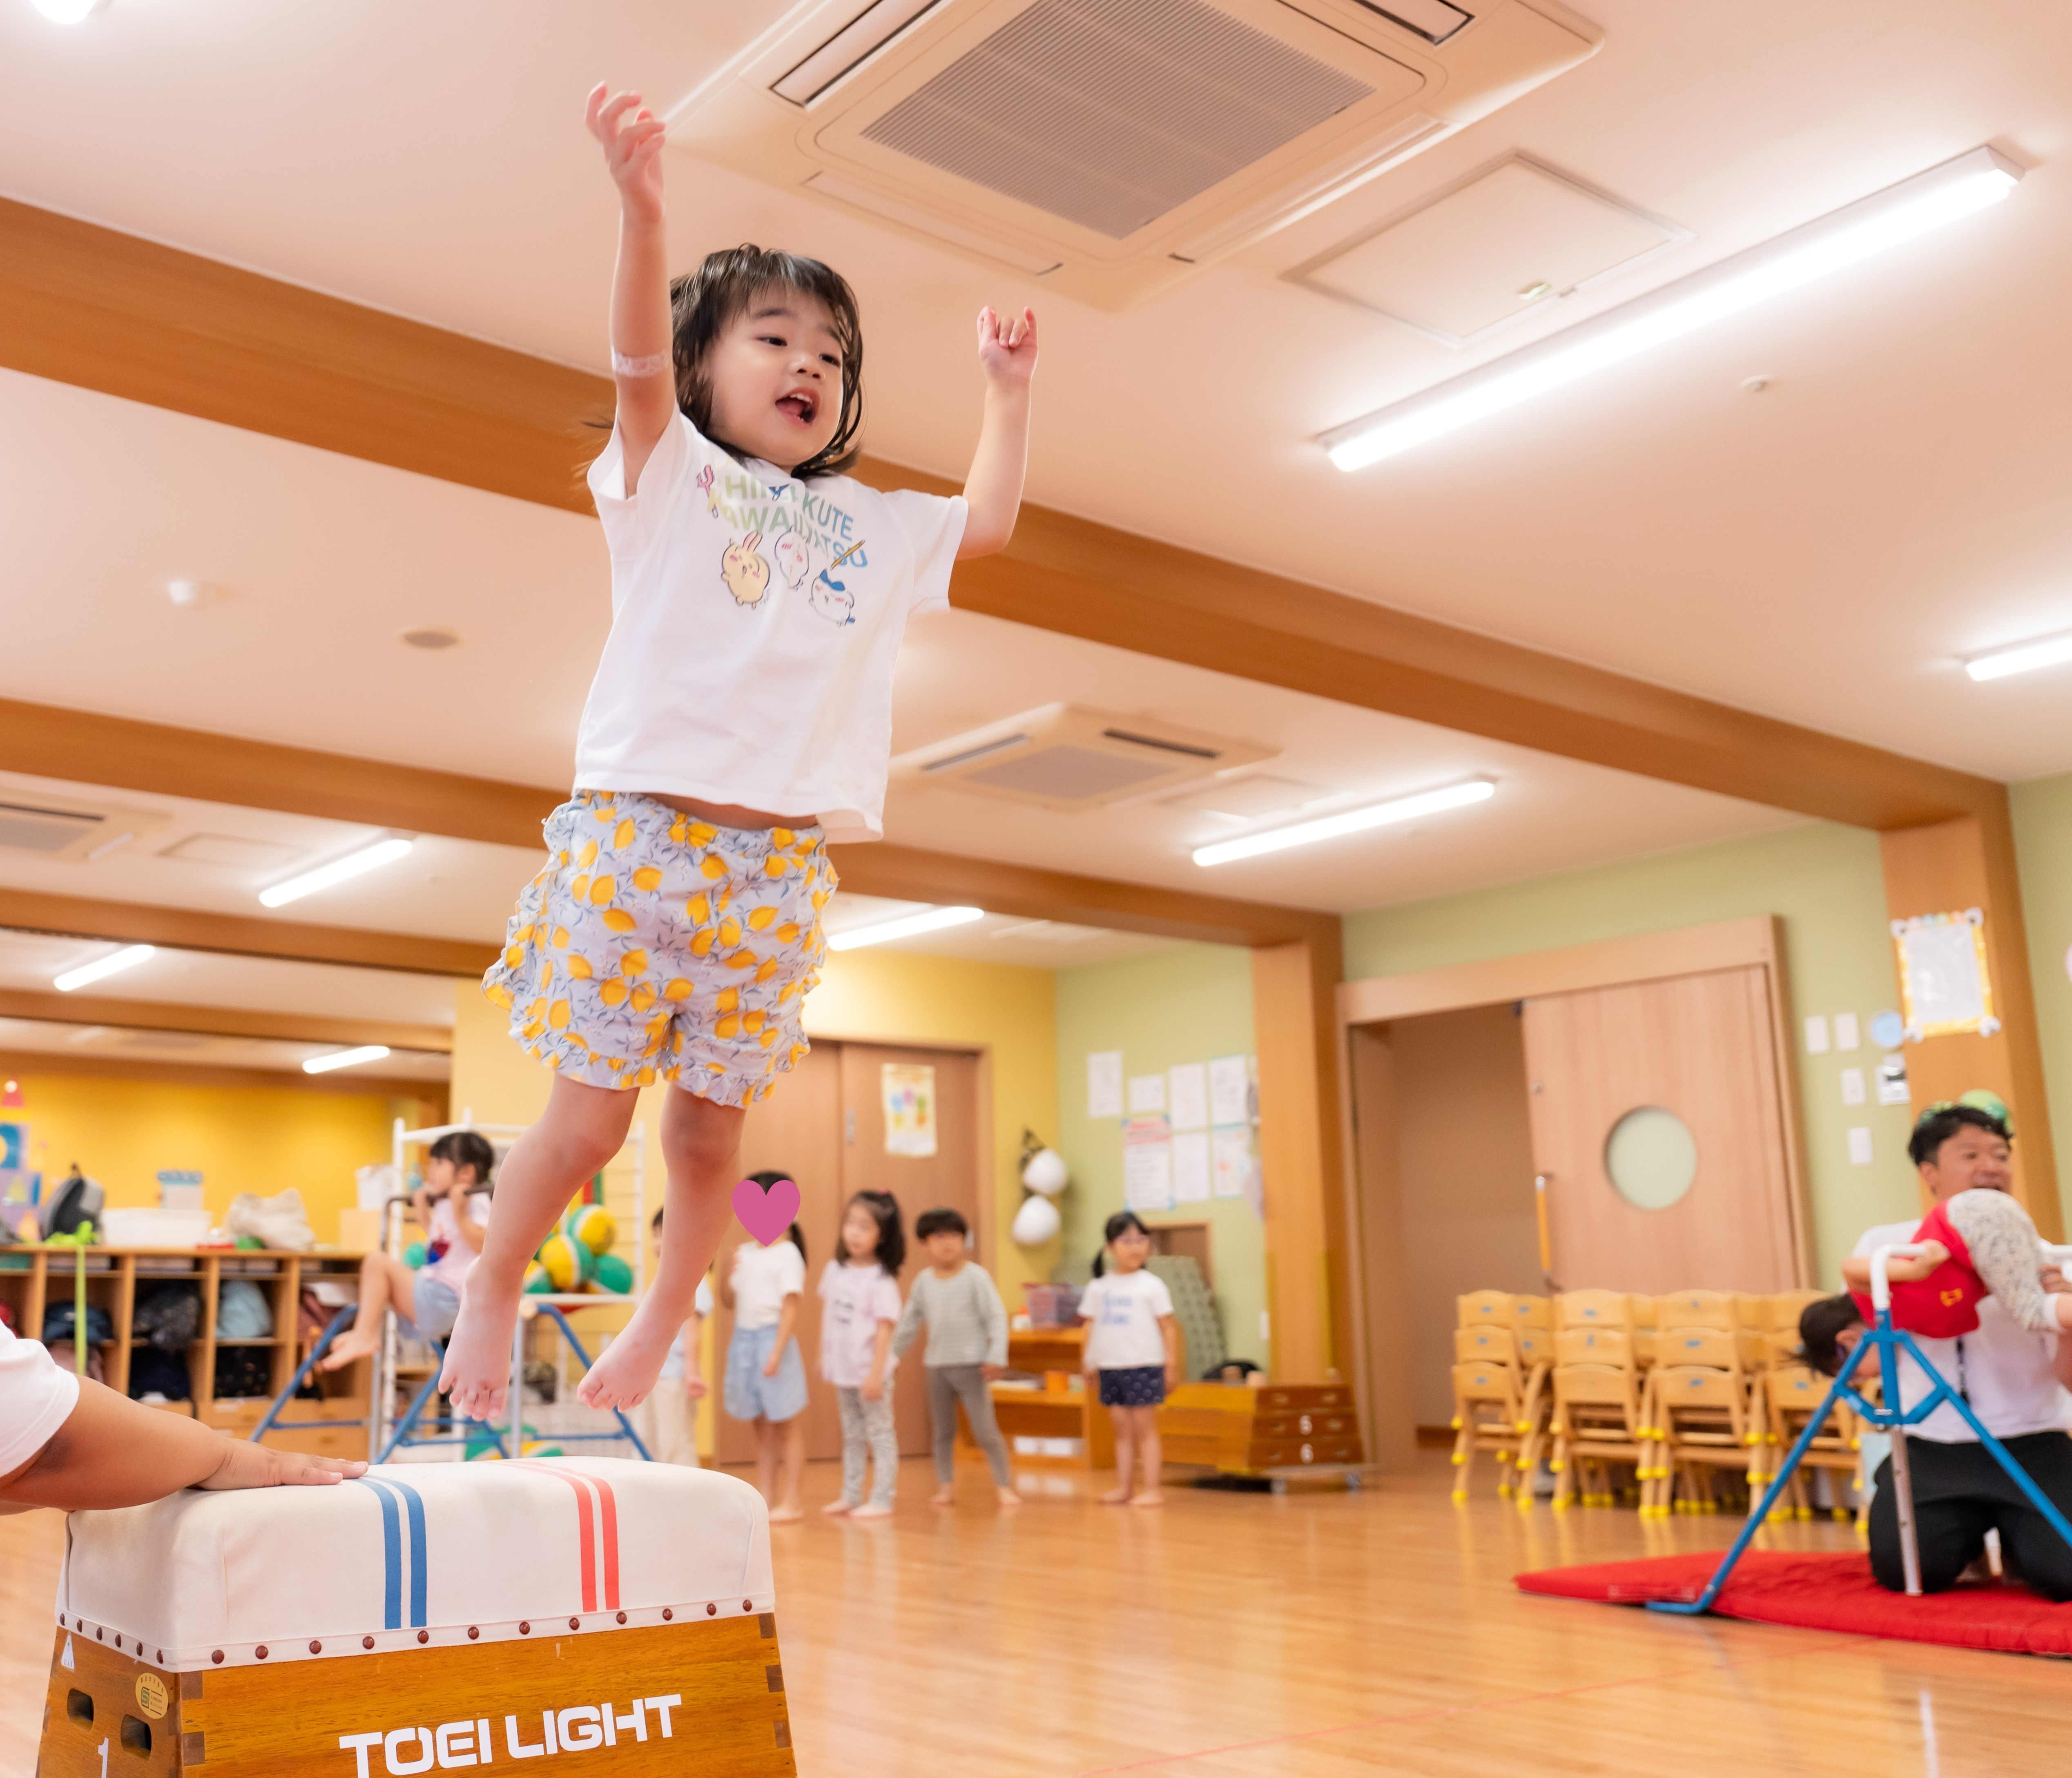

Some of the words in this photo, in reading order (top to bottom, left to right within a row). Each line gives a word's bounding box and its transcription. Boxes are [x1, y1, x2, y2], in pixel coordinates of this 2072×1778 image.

[98, 1737, 109, 1778] 1
[339, 1718, 493, 1778] TOEI
[505, 1694, 682, 1759] LIGHT
